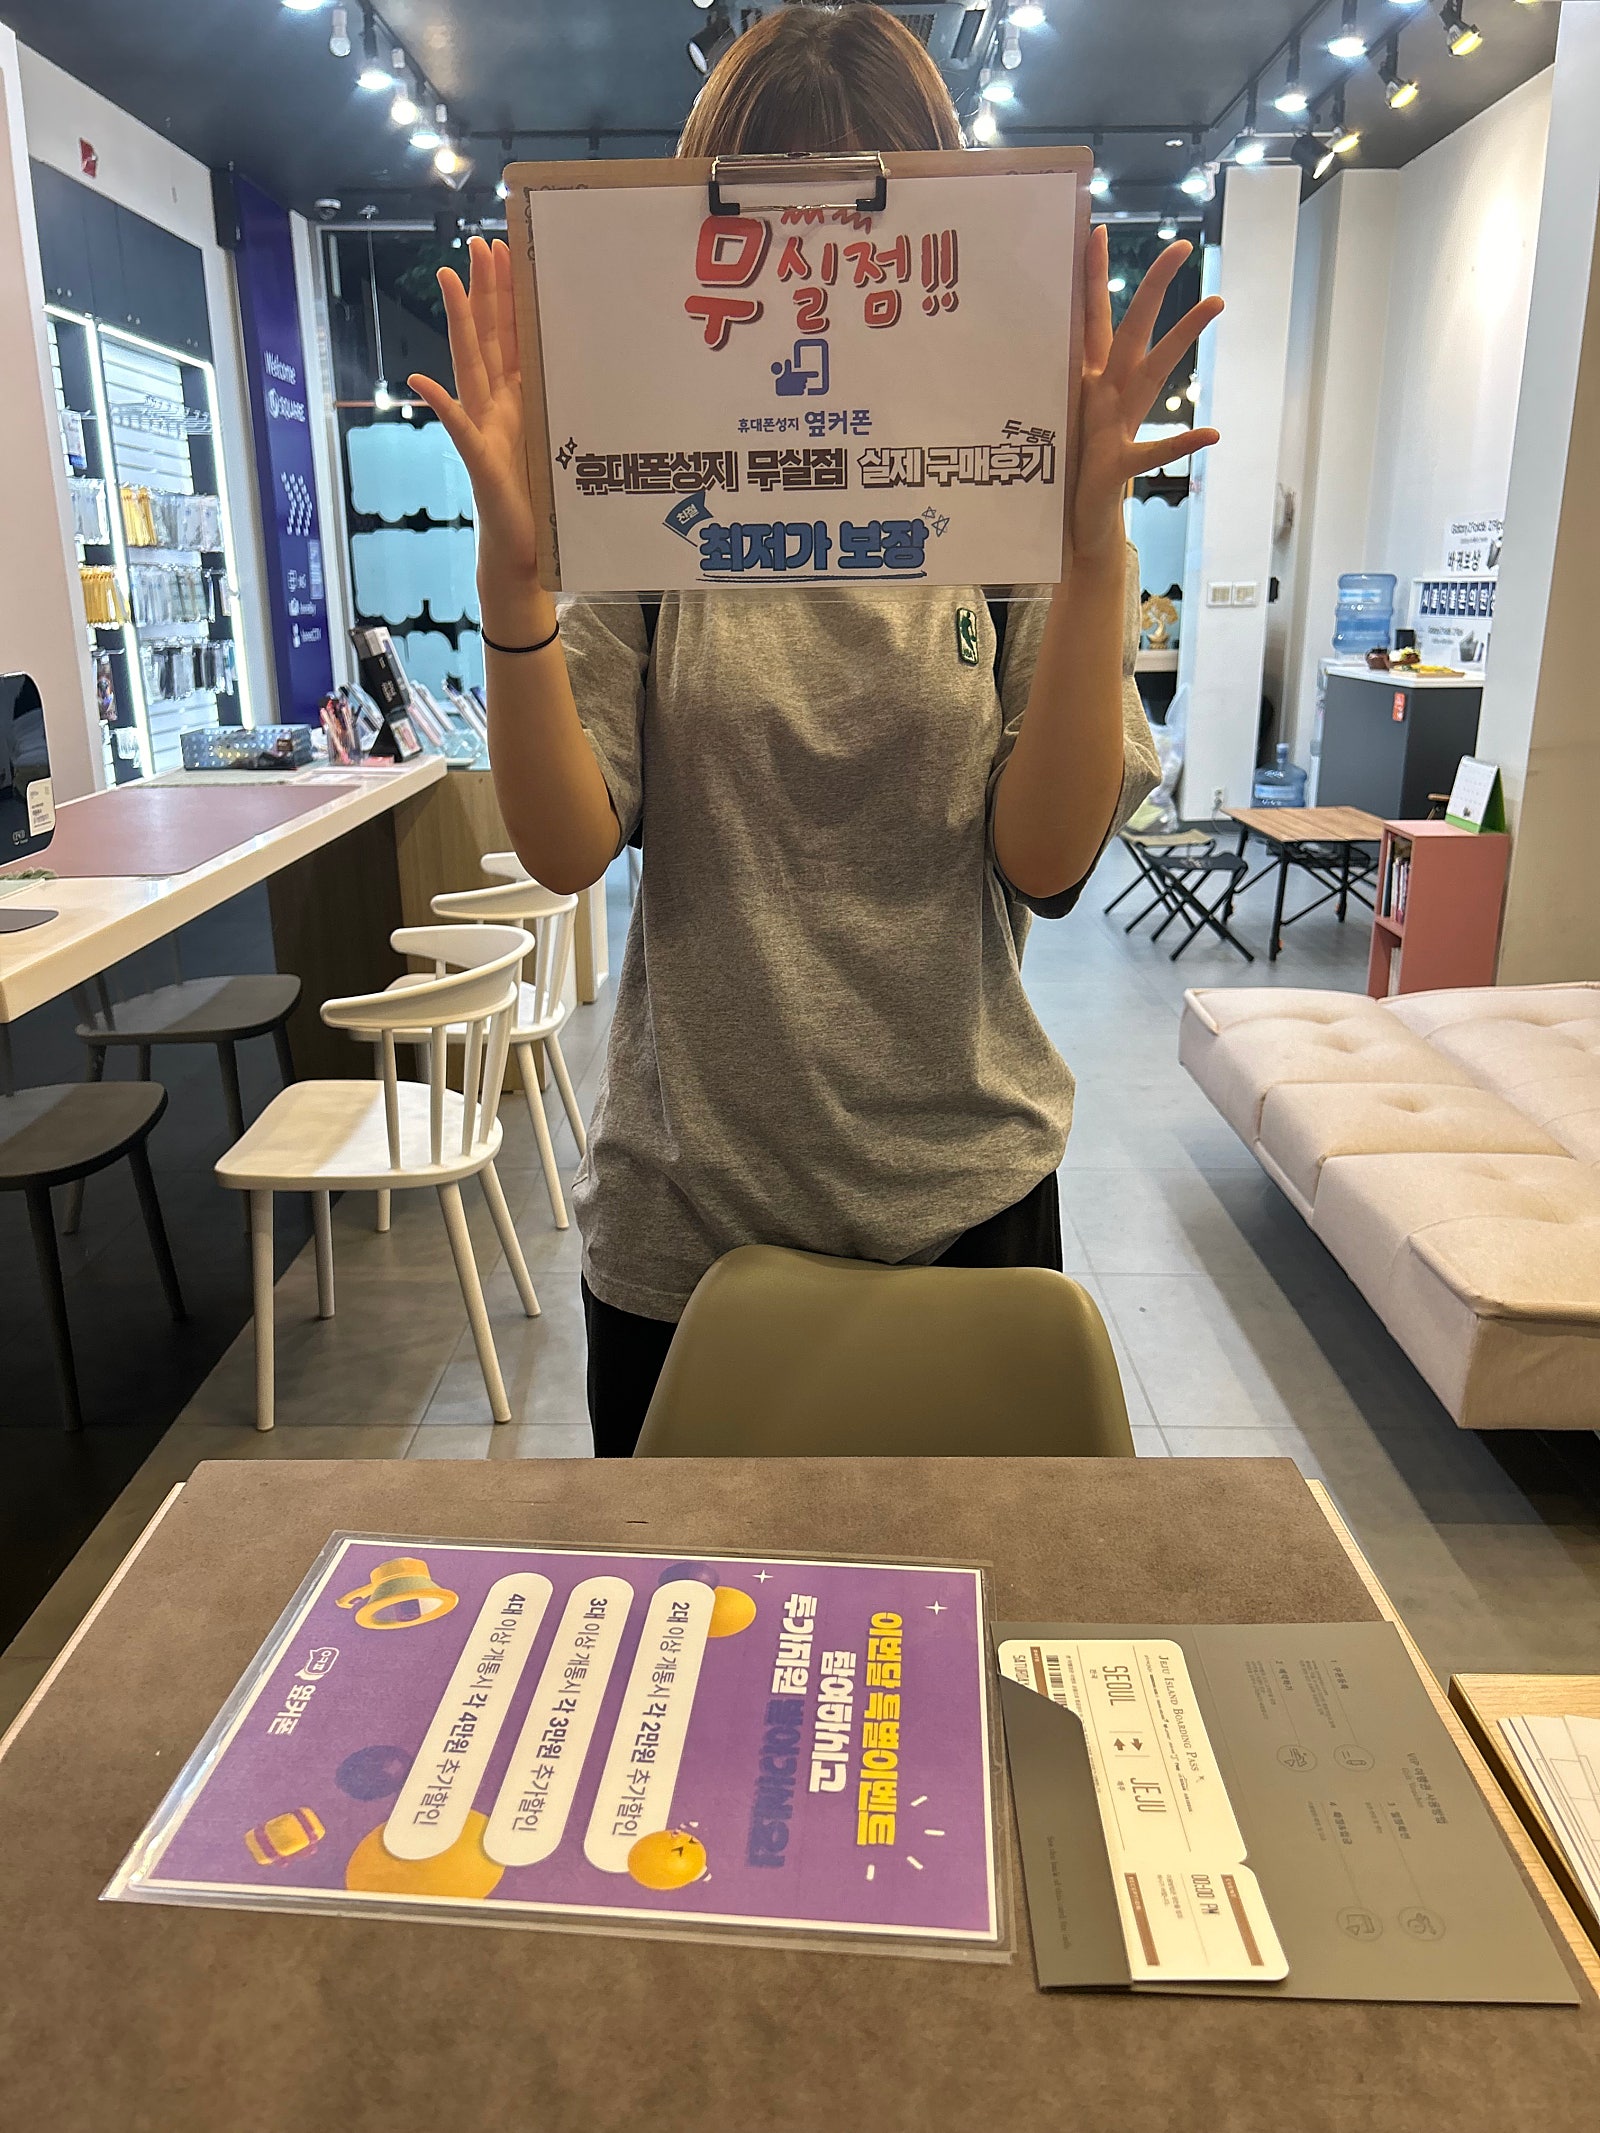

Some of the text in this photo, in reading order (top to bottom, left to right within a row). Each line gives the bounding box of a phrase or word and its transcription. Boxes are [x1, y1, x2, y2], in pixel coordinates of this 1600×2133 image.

[684, 215, 960, 351] 무실점!!
[264, 349, 296, 386] Welcome
[737, 409, 873, 437] 휴대폰성지 옆커폰
[575, 442, 1056, 496] 휴대폰성지 무실점 실제 구매후기
[676, 503, 700, 525] 친절
[699, 517, 930, 572] 최저가 보장
[771, 1593, 818, 1695] 추가지원
[266, 1684, 317, 1735] 옆커폰
[412, 1593, 527, 1826] 4대 이상 개통시 각 4만원 추가할인
[511, 1597, 608, 1832] 3대 이상 개통시 각 3만원 추가할인
[611, 1601, 691, 1838] 2대 이상 개통시 각 2만원 추가할인
[808, 1650, 857, 1793] 참여하시고
[856, 1611, 903, 1846] 이번달 특별이벤트
[1102, 1665, 1167, 1813] SEOUL JEJU
[1407, 1752, 1448, 1824] VIP 여행권 사용방법
[1128, 1876, 1142, 1911] RECEPTION
[1190, 1874, 1220, 1915] 00:00 PM
[1225, 1877, 1237, 1898] EVENT
